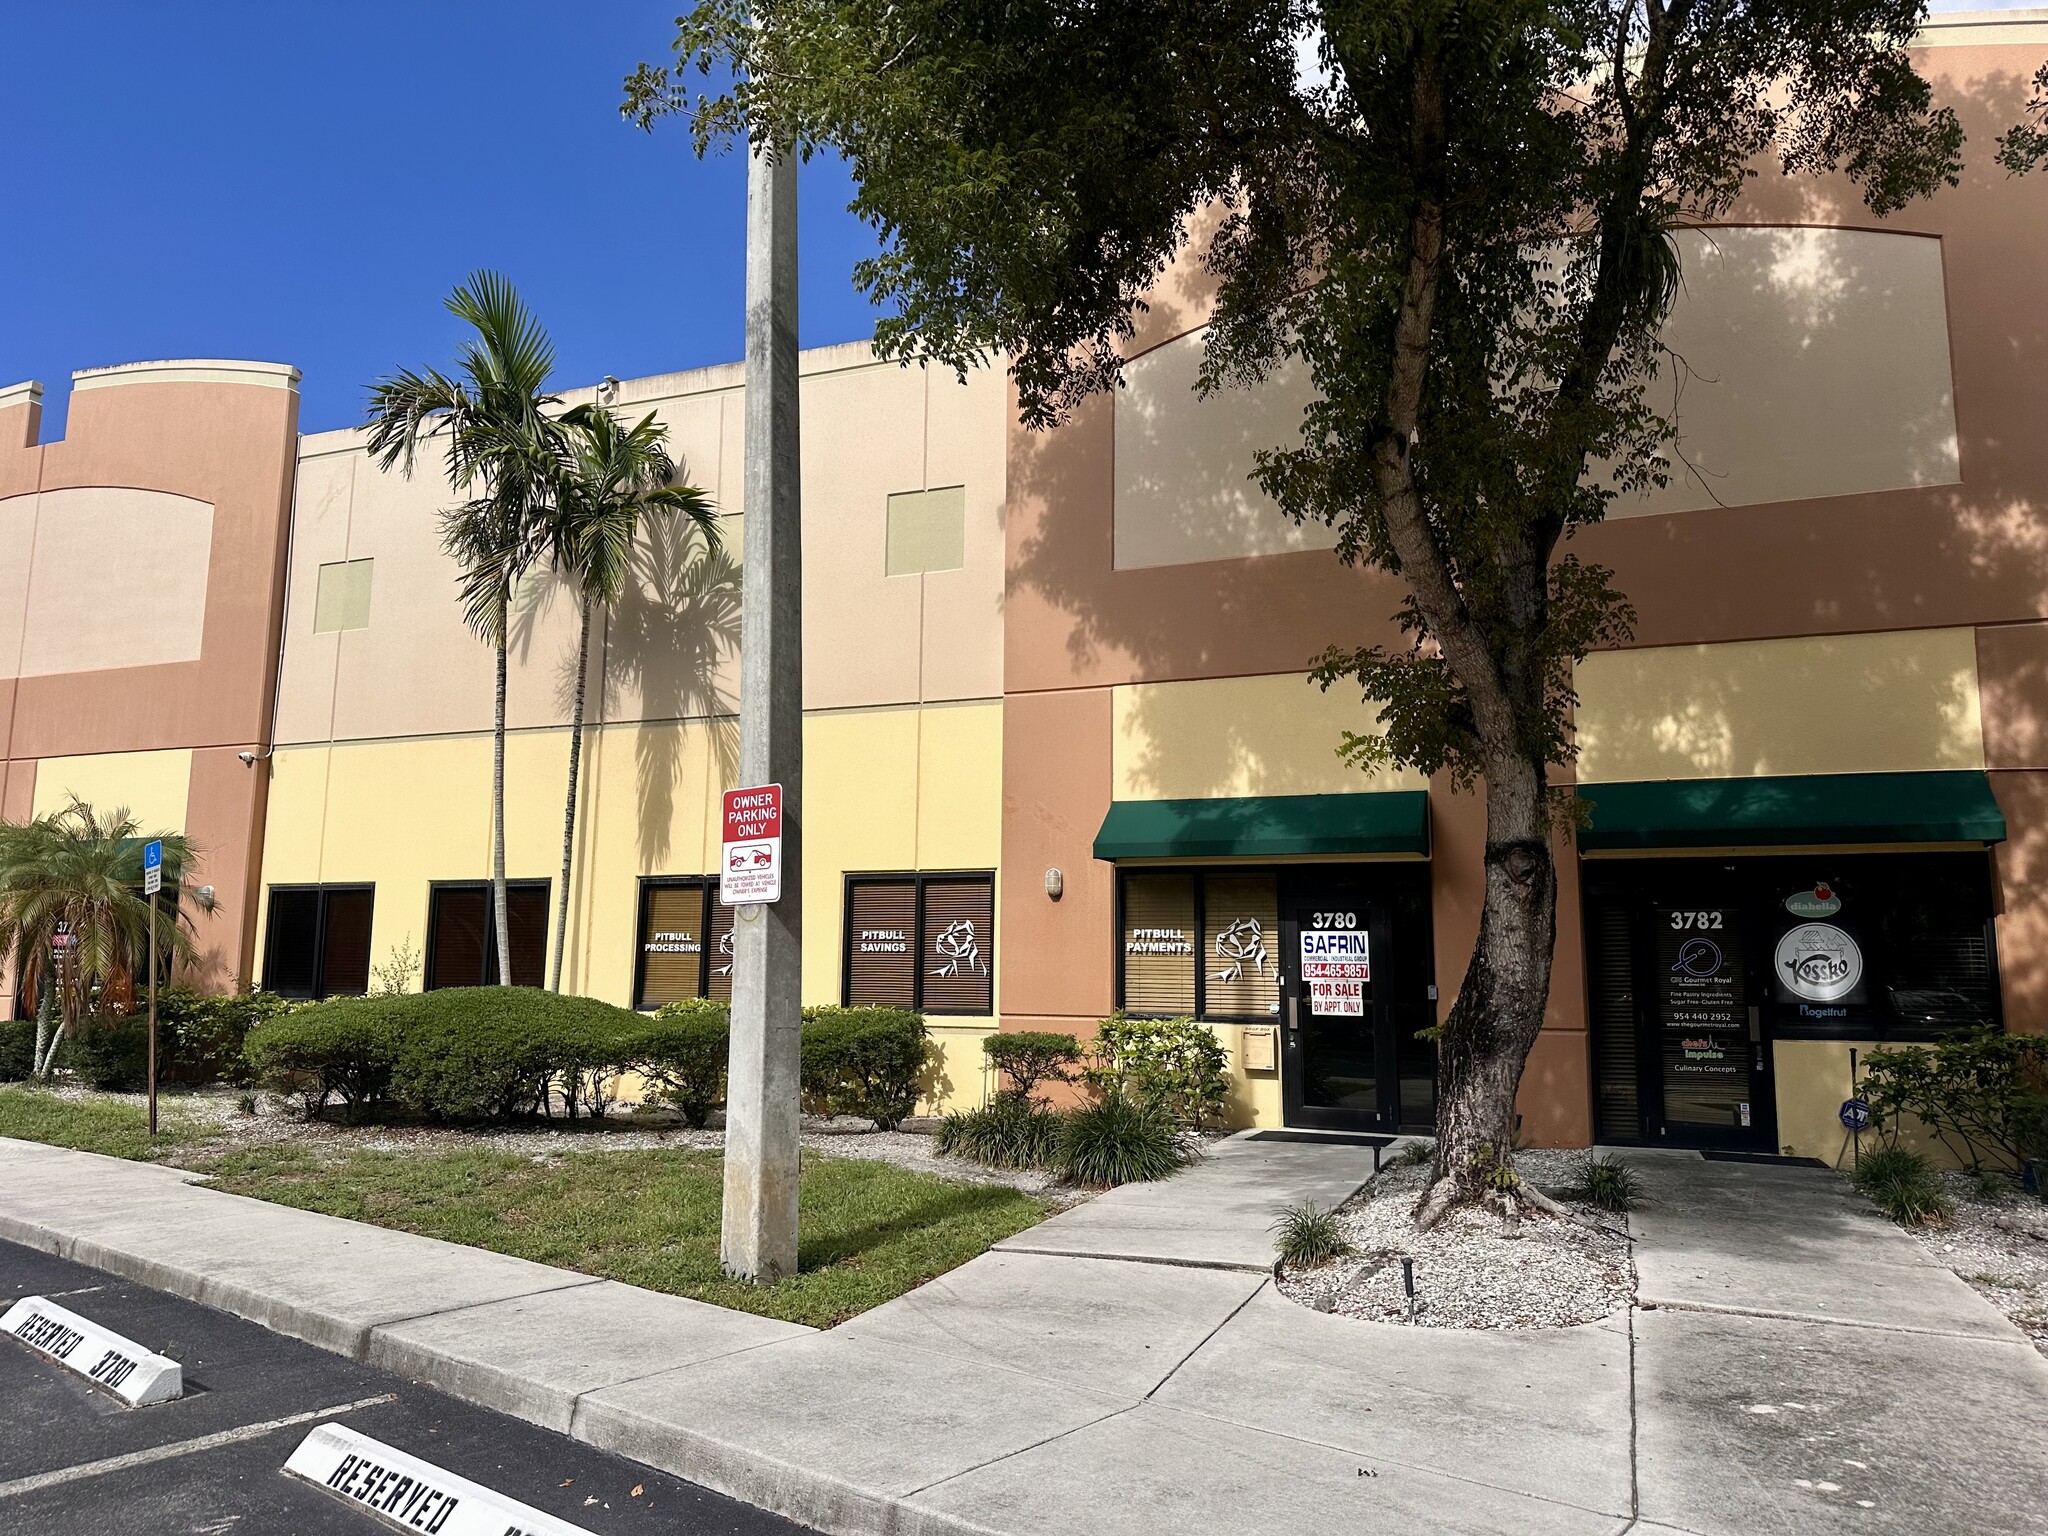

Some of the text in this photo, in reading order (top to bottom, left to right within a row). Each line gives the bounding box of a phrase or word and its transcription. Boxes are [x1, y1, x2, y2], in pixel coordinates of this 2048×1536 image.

[733, 793, 773, 809] OWNER
[728, 807, 777, 824] PARKING
[737, 822, 767, 837] ONLY
[1312, 912, 1357, 929] 3780
[1670, 911, 1723, 930] 3782
[655, 932, 692, 941] PITBULL
[862, 930, 906, 940] PITBULL
[1133, 928, 1185, 939] PITBULL
[645, 944, 702, 952] PROCESSING
[860, 942, 906, 952] SAVINGS
[1126, 942, 1192, 952] PAYMENTS
[1304, 935, 1366, 954] SAFRIN
[1304, 963, 1367, 978] 954-465-9857
[1684, 976, 1713, 984] Gourmet
[1714, 976, 1732, 985] Royal
[1312, 983, 1360, 996] FOR SALE
[1314, 1000, 1361, 1013] BY APPT. ONLY
[1673, 1012, 1731, 1021] 954 440 2952
[1674, 1064, 1737, 1074] Culinary Concepts
[14, 1312, 138, 1389] RESERVED 3780
[326, 1453, 460, 1535] RESERVED
